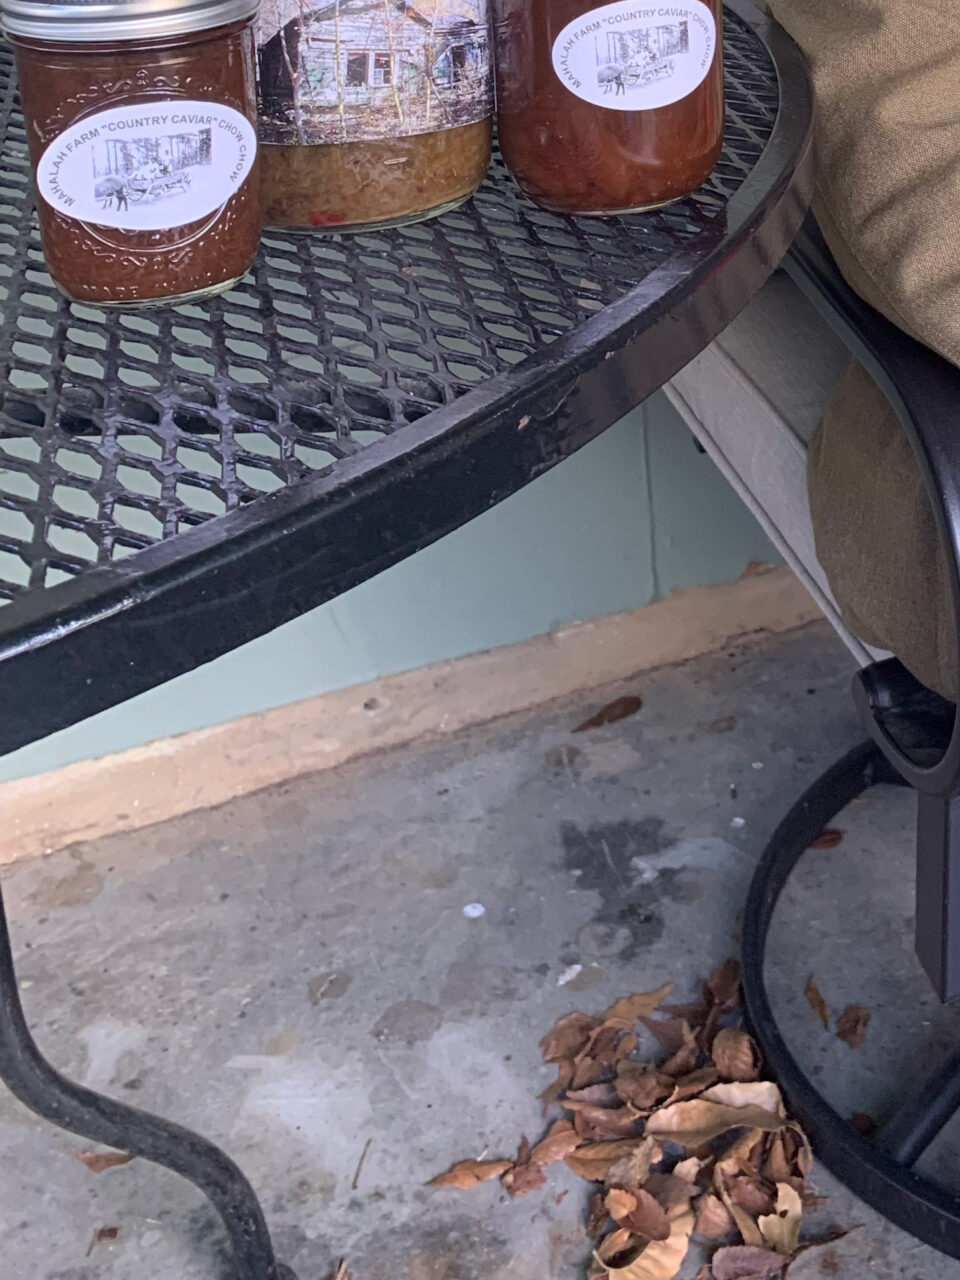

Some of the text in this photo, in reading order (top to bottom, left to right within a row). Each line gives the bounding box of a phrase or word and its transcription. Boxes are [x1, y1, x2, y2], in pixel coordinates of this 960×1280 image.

[560, 39, 582, 89] MAHALAH
[574, 22, 602, 41] FARM
[602, 9, 656, 25] "COUNTRY
[692, 13, 710, 36] CHOW
[701, 36, 712, 70] CHOW
[101, 115, 169, 132] "COUNTRY
[218, 119, 245, 143] CHOW
[65, 127, 101, 154] FARM
[49, 151, 76, 207] MAHALAH
[230, 144, 247, 183] CHOW
